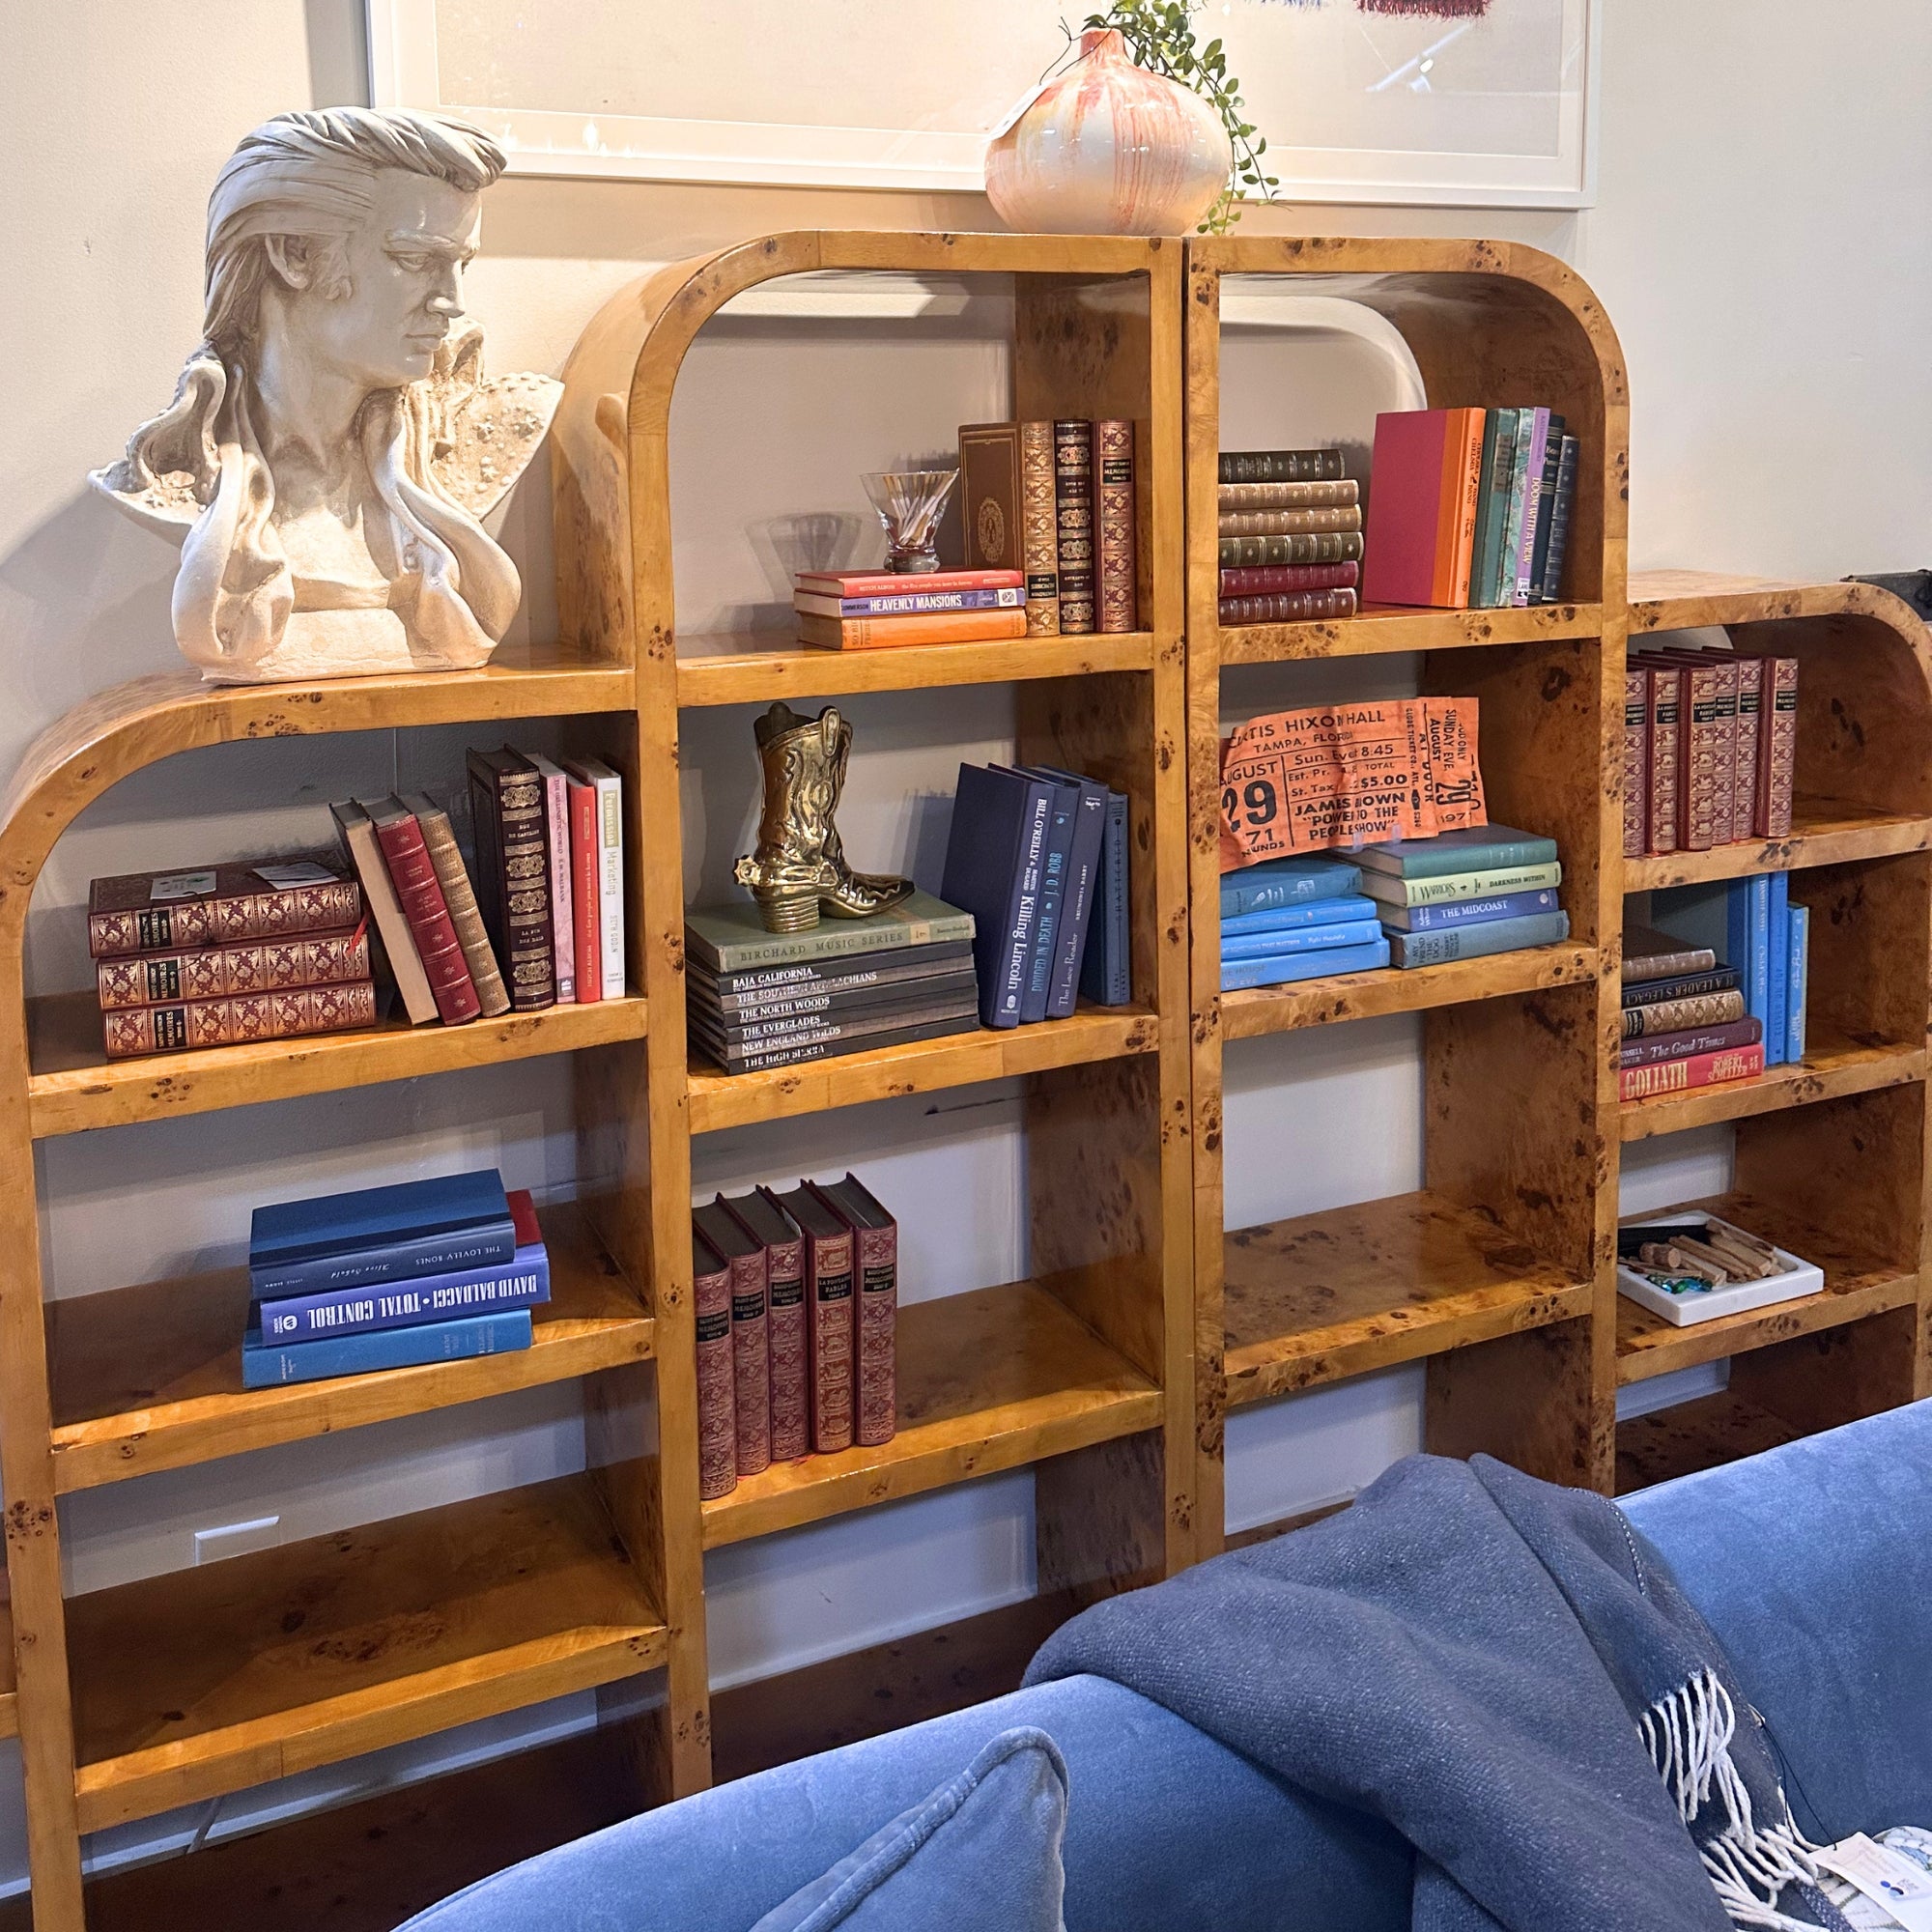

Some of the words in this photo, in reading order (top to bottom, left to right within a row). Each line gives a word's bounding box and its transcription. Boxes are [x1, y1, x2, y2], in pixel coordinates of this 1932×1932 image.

[1530, 477, 1542, 506] DOOM
[1526, 507, 1538, 530] WITH
[1522, 541, 1534, 565] VIEW
[869, 598, 914, 612] HEAVENLY
[916, 594, 962, 609] MANSIONS
[1286, 715, 1344, 732] HIXON
[1347, 711, 1385, 724] HALL
[1443, 708, 1457, 747] SUNDAY
[1254, 738, 1306, 753] TAMPA,
[1407, 729, 1417, 754] TICKET
[1430, 718, 1441, 761] AUGUST
[1294, 753, 1328, 765] Sun.
[1361, 744, 1393, 757] 8:45
[1443, 752, 1455, 772] EVE.
[1457, 741, 1467, 761] ONLY
[1220, 760, 1278, 787] AUGUST
[1289, 771, 1309, 781] Est.
[1313, 768, 1330, 778] Pr.
[1292, 787, 1308, 797] St.
[1311, 784, 1334, 794] Tax
[1361, 774, 1407, 789] $5.00
[1435, 779, 1471, 806] 29
[1035, 798, 1047, 819] BILL
[1221, 780, 1278, 833] 29
[1294, 798, 1351, 816] JAMES
[1375, 806, 1399, 817] THE
[1440, 811, 1471, 823] 197
[605, 792, 619, 846] Permission
[1029, 819, 1044, 862] O'REILLY
[1309, 824, 1353, 840] PEOPLE
[605, 851, 618, 896] Marketing
[1047, 852, 1063, 874] ROBB
[1045, 877, 1060, 886] D.
[1489, 877, 1522, 888] DARKNESS
[1523, 873, 1546, 883] WITHIN
[1012, 895, 1035, 940] Killing
[1440, 908, 1461, 919] THE
[1462, 899, 1509, 916] MIDCOAST
[1037, 916, 1054, 944] DEATH
[741, 945, 806, 961] BIRCHARD
[815, 938, 855, 952] MUSIC
[862, 932, 903, 946] SERIES
[1036, 947, 1049, 955] IN
[1064, 932, 1078, 965] Reader
[1412, 945, 1419, 958] MY
[1008, 942, 1028, 990] Lincoln
[1031, 958, 1046, 992] DIVIDED
[1061, 967, 1074, 987] Lace
[732, 978, 755, 989] BAJA
[757, 967, 812, 984] CALIFORNIA
[1665, 979, 1714, 997] LEADER'S
[737, 993, 755, 1004] THE
[739, 1009, 758, 1020] THE
[760, 1003, 792, 1017] NORTH
[795, 997, 831, 1011] WOODS
[1058, 988, 1070, 1007] The
[1624, 989, 1663, 1006] LEGACY
[742, 1027, 760, 1037] THE
[763, 1015, 820, 1034] EVERGLADES
[742, 1040, 763, 1053] NEW
[766, 1030, 810, 1046] ENGLAND
[1650, 1044, 1669, 1059] The
[1672, 1039, 1695, 1054] Good
[1697, 1037, 1725, 1050] Times
[744, 1055, 764, 1068] THE
[766, 1049, 790, 1064] HIGH
[1713, 1056, 1743, 1070] ROBERT
[1625, 1062, 1688, 1099] GOLIATH
[415, 1255, 443, 1265] BONES
[446, 1248, 481, 1261] LOVELY
[485, 1245, 501, 1254] THE
[433, 1281, 497, 1309] BALDACCI
[498, 1274, 537, 1298] DAVID
[307, 1299, 374, 1329] CONTROL
[378, 1292, 422, 1318] TOTAL
